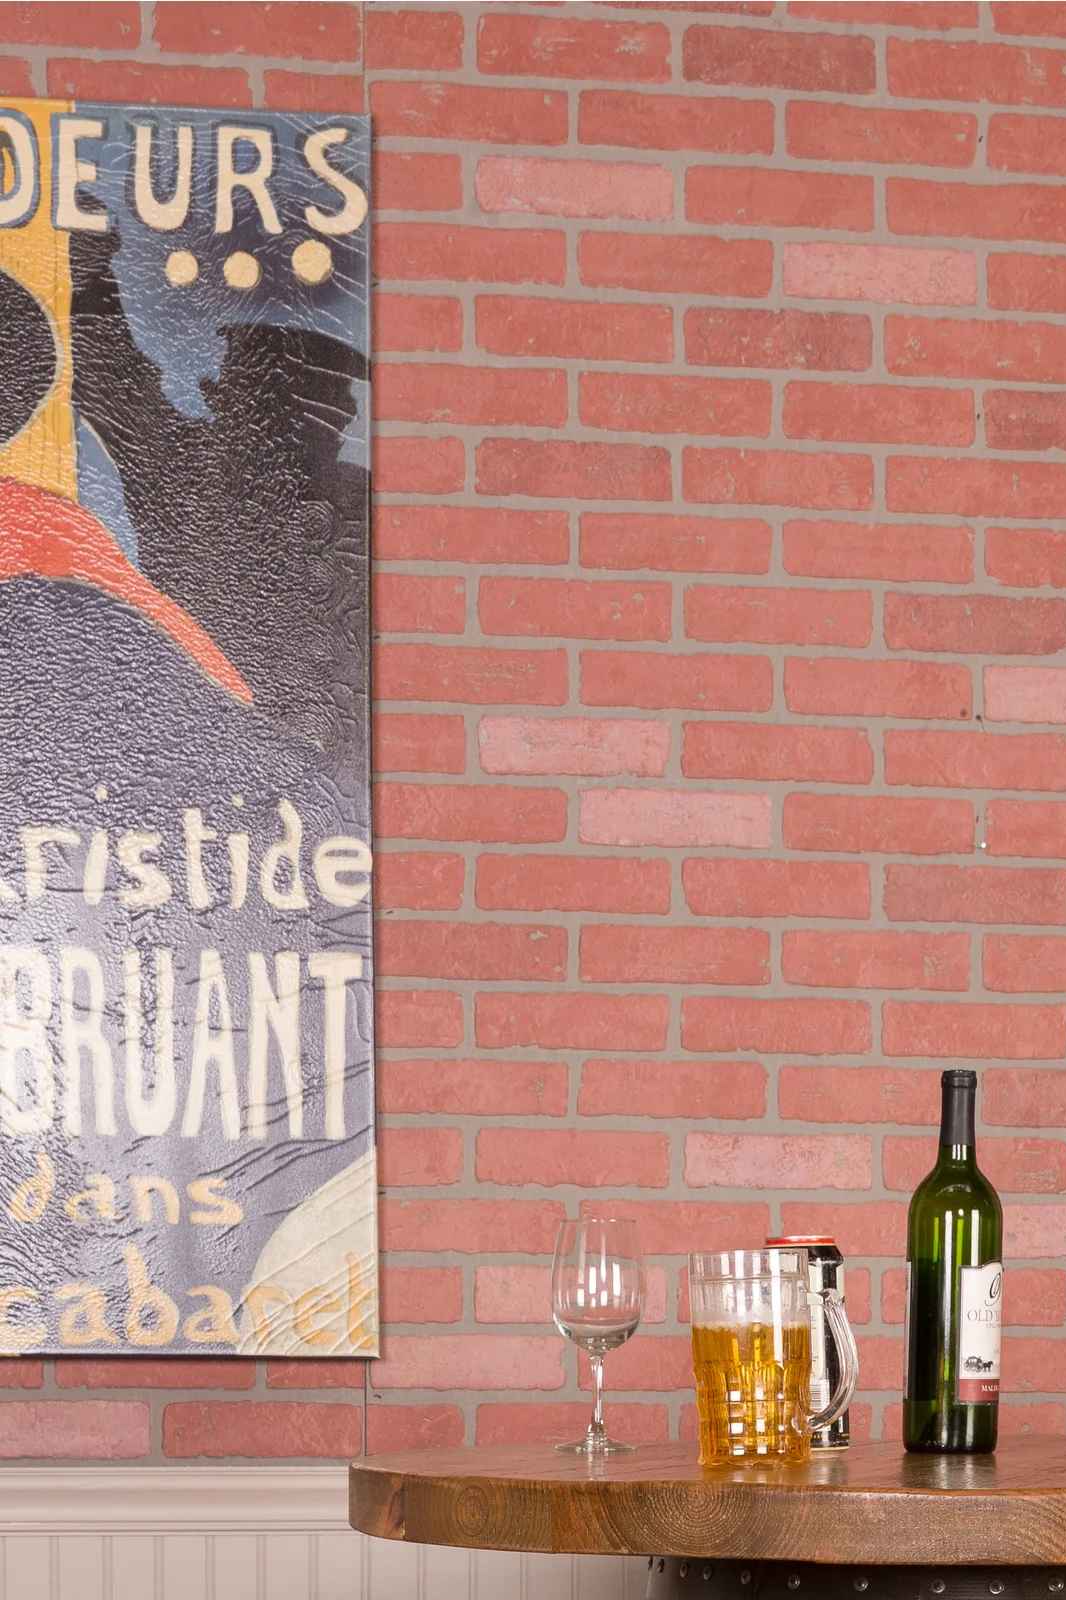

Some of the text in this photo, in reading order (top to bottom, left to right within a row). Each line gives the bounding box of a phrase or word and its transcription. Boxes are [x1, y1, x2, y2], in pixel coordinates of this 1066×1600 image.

[0, 787, 373, 911] ristide
[0, 945, 364, 1141] BRUANT
[8, 1150, 244, 1226] dans
